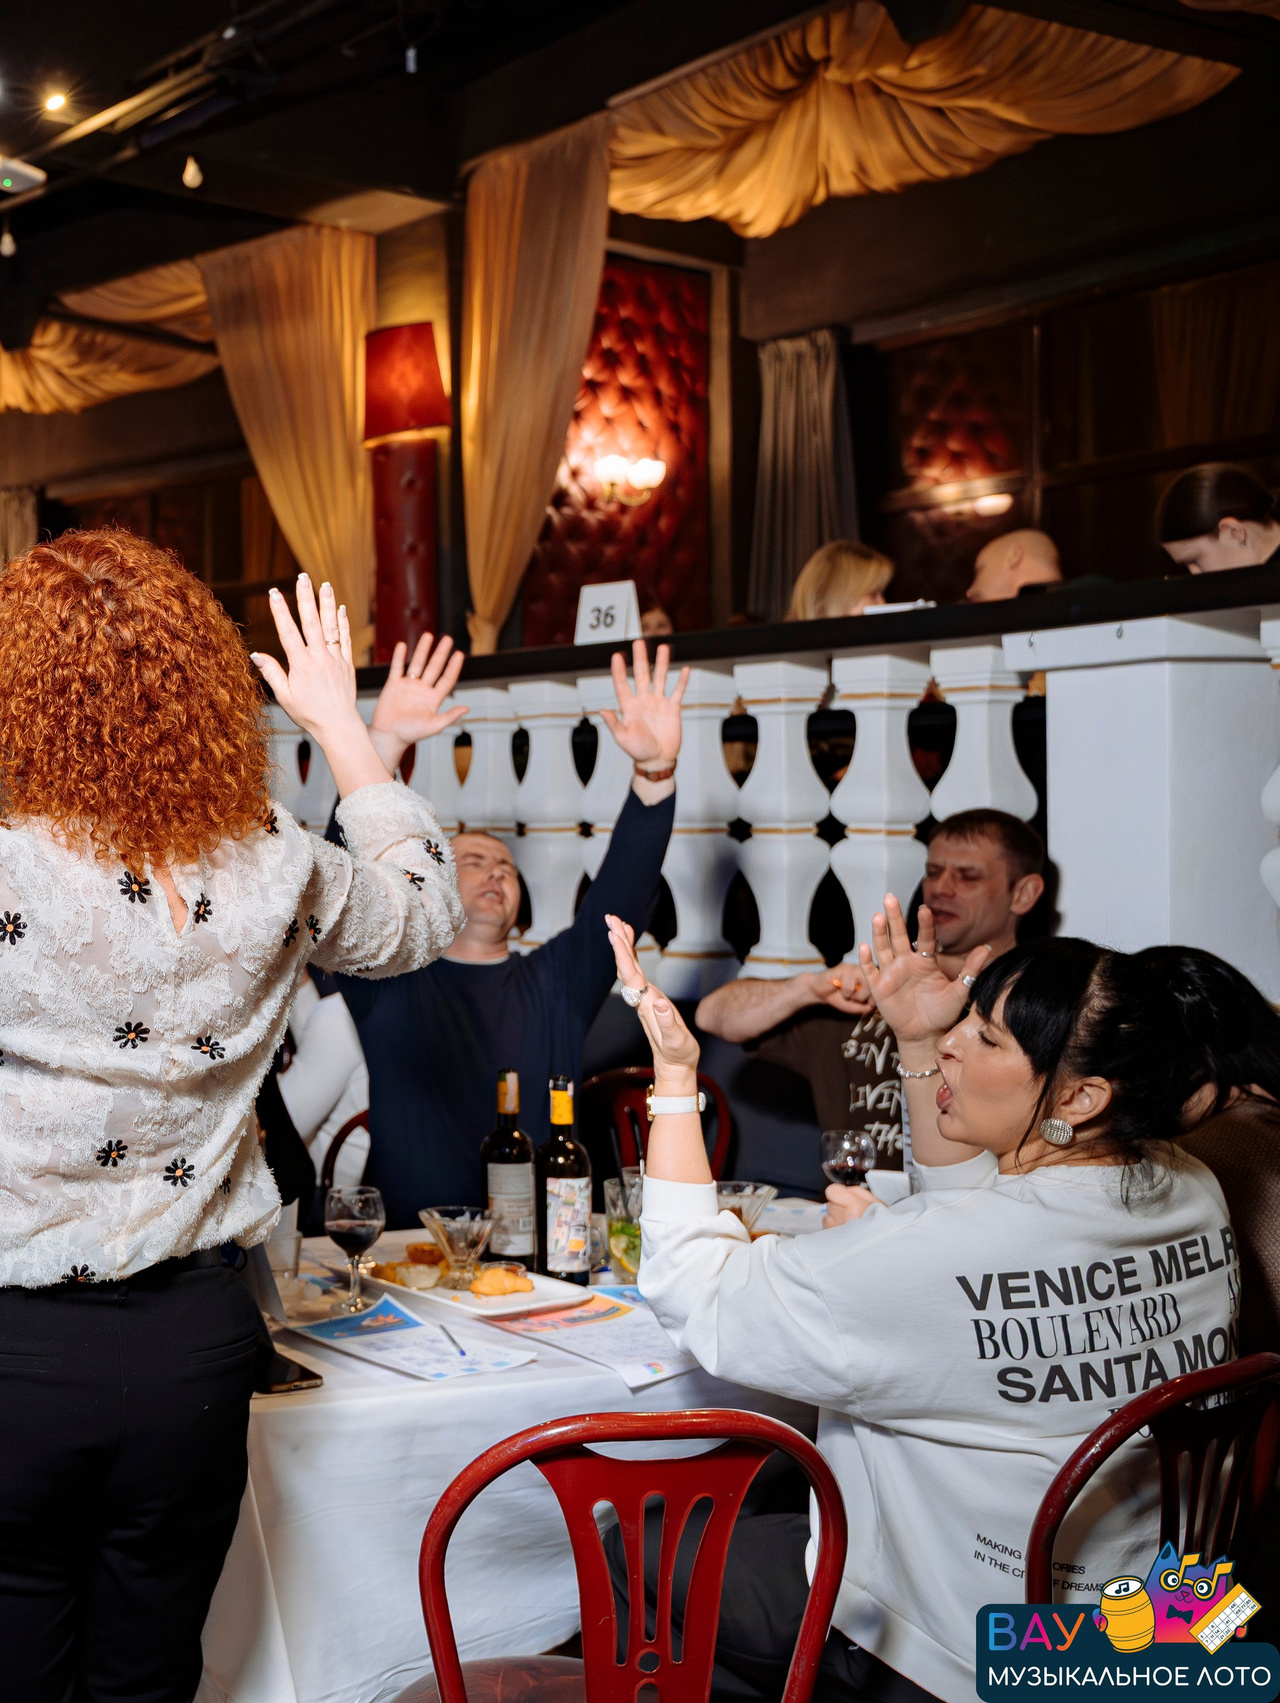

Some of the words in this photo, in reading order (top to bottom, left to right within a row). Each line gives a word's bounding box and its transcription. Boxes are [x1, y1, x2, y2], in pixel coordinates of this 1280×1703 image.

[589, 605, 615, 629] 36
[956, 1256, 1142, 1311] VENICE
[970, 1292, 1182, 1360] BOULEVARD
[996, 1347, 1170, 1404] SANTA
[974, 1550, 986, 1562] IN
[987, 1556, 1011, 1574] THE
[976, 1533, 1022, 1560] MAKING
